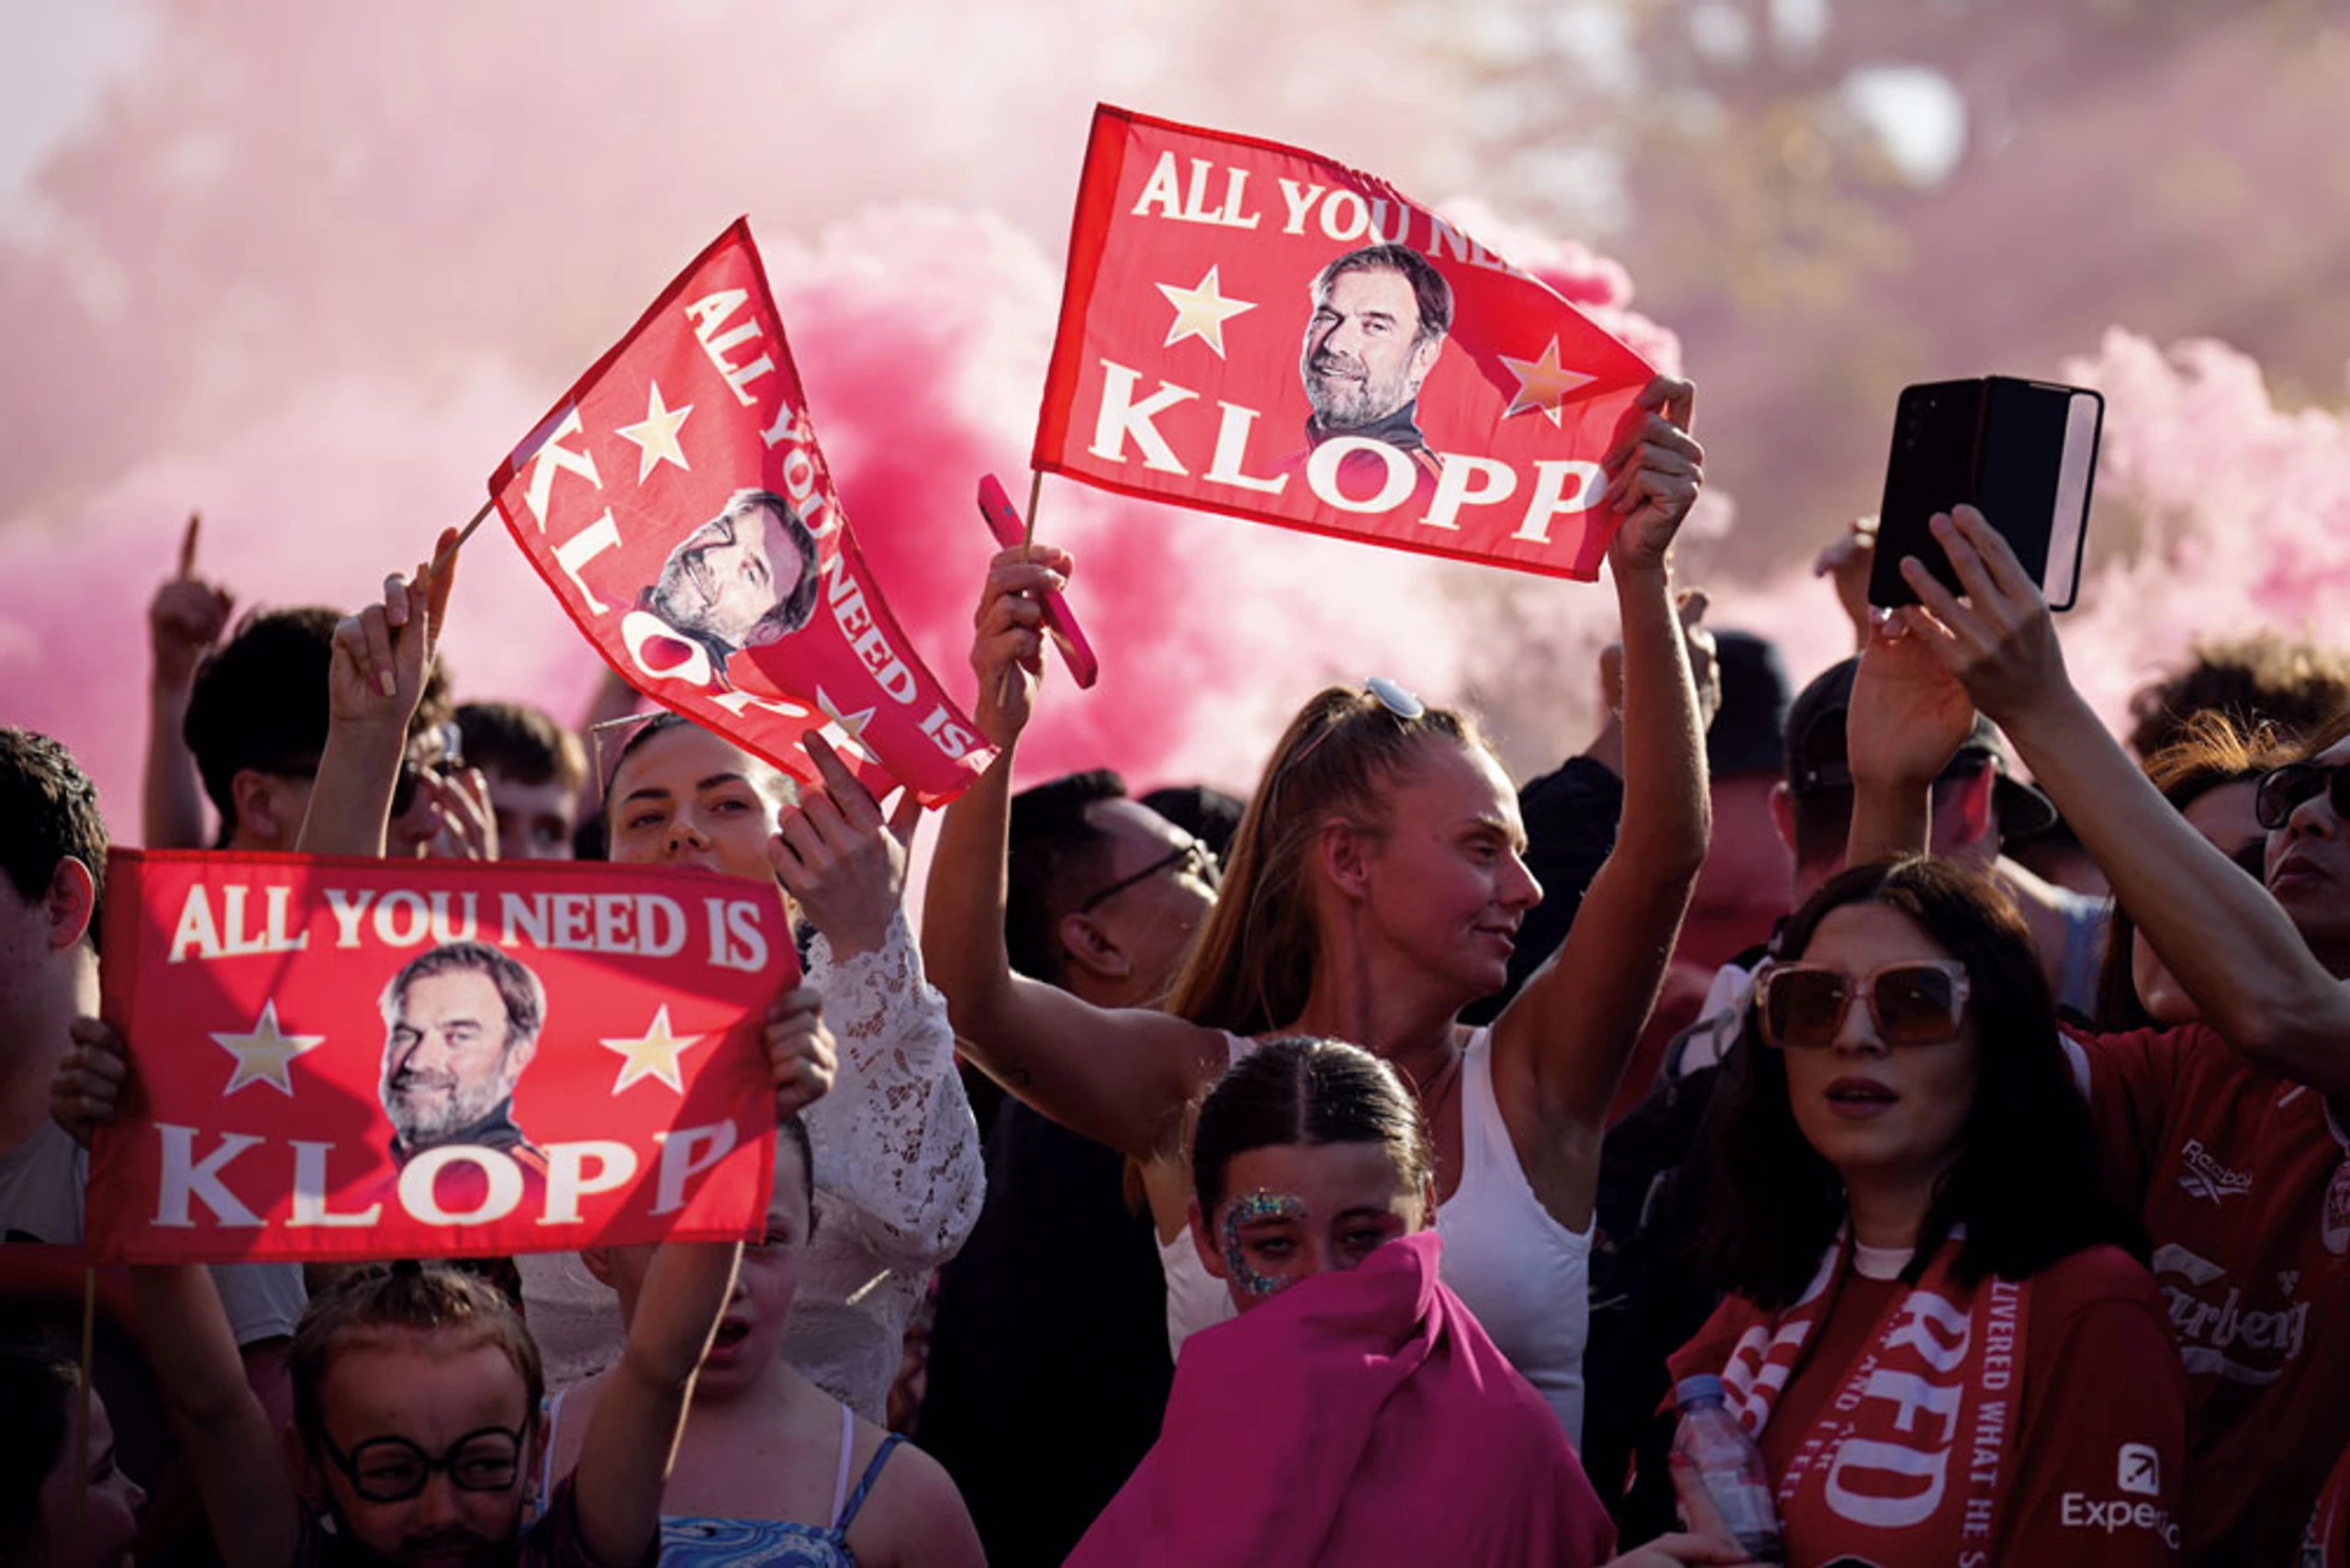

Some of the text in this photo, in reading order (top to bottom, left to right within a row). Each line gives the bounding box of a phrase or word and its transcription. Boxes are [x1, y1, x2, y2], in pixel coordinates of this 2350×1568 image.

[1132, 151, 1528, 281] ALL YOU NE
[1088, 359, 1610, 545] KLOPP
[686, 287, 976, 759] ALL YOU NEED IS
[168, 883, 769, 973] ALL YOU NEED IS
[150, 1117, 738, 1229] KLOPP
[1982, 1272, 2020, 1391] LIVERED
[1969, 1401, 2009, 1489] WHAT
[1960, 1497, 1995, 1540] HE
